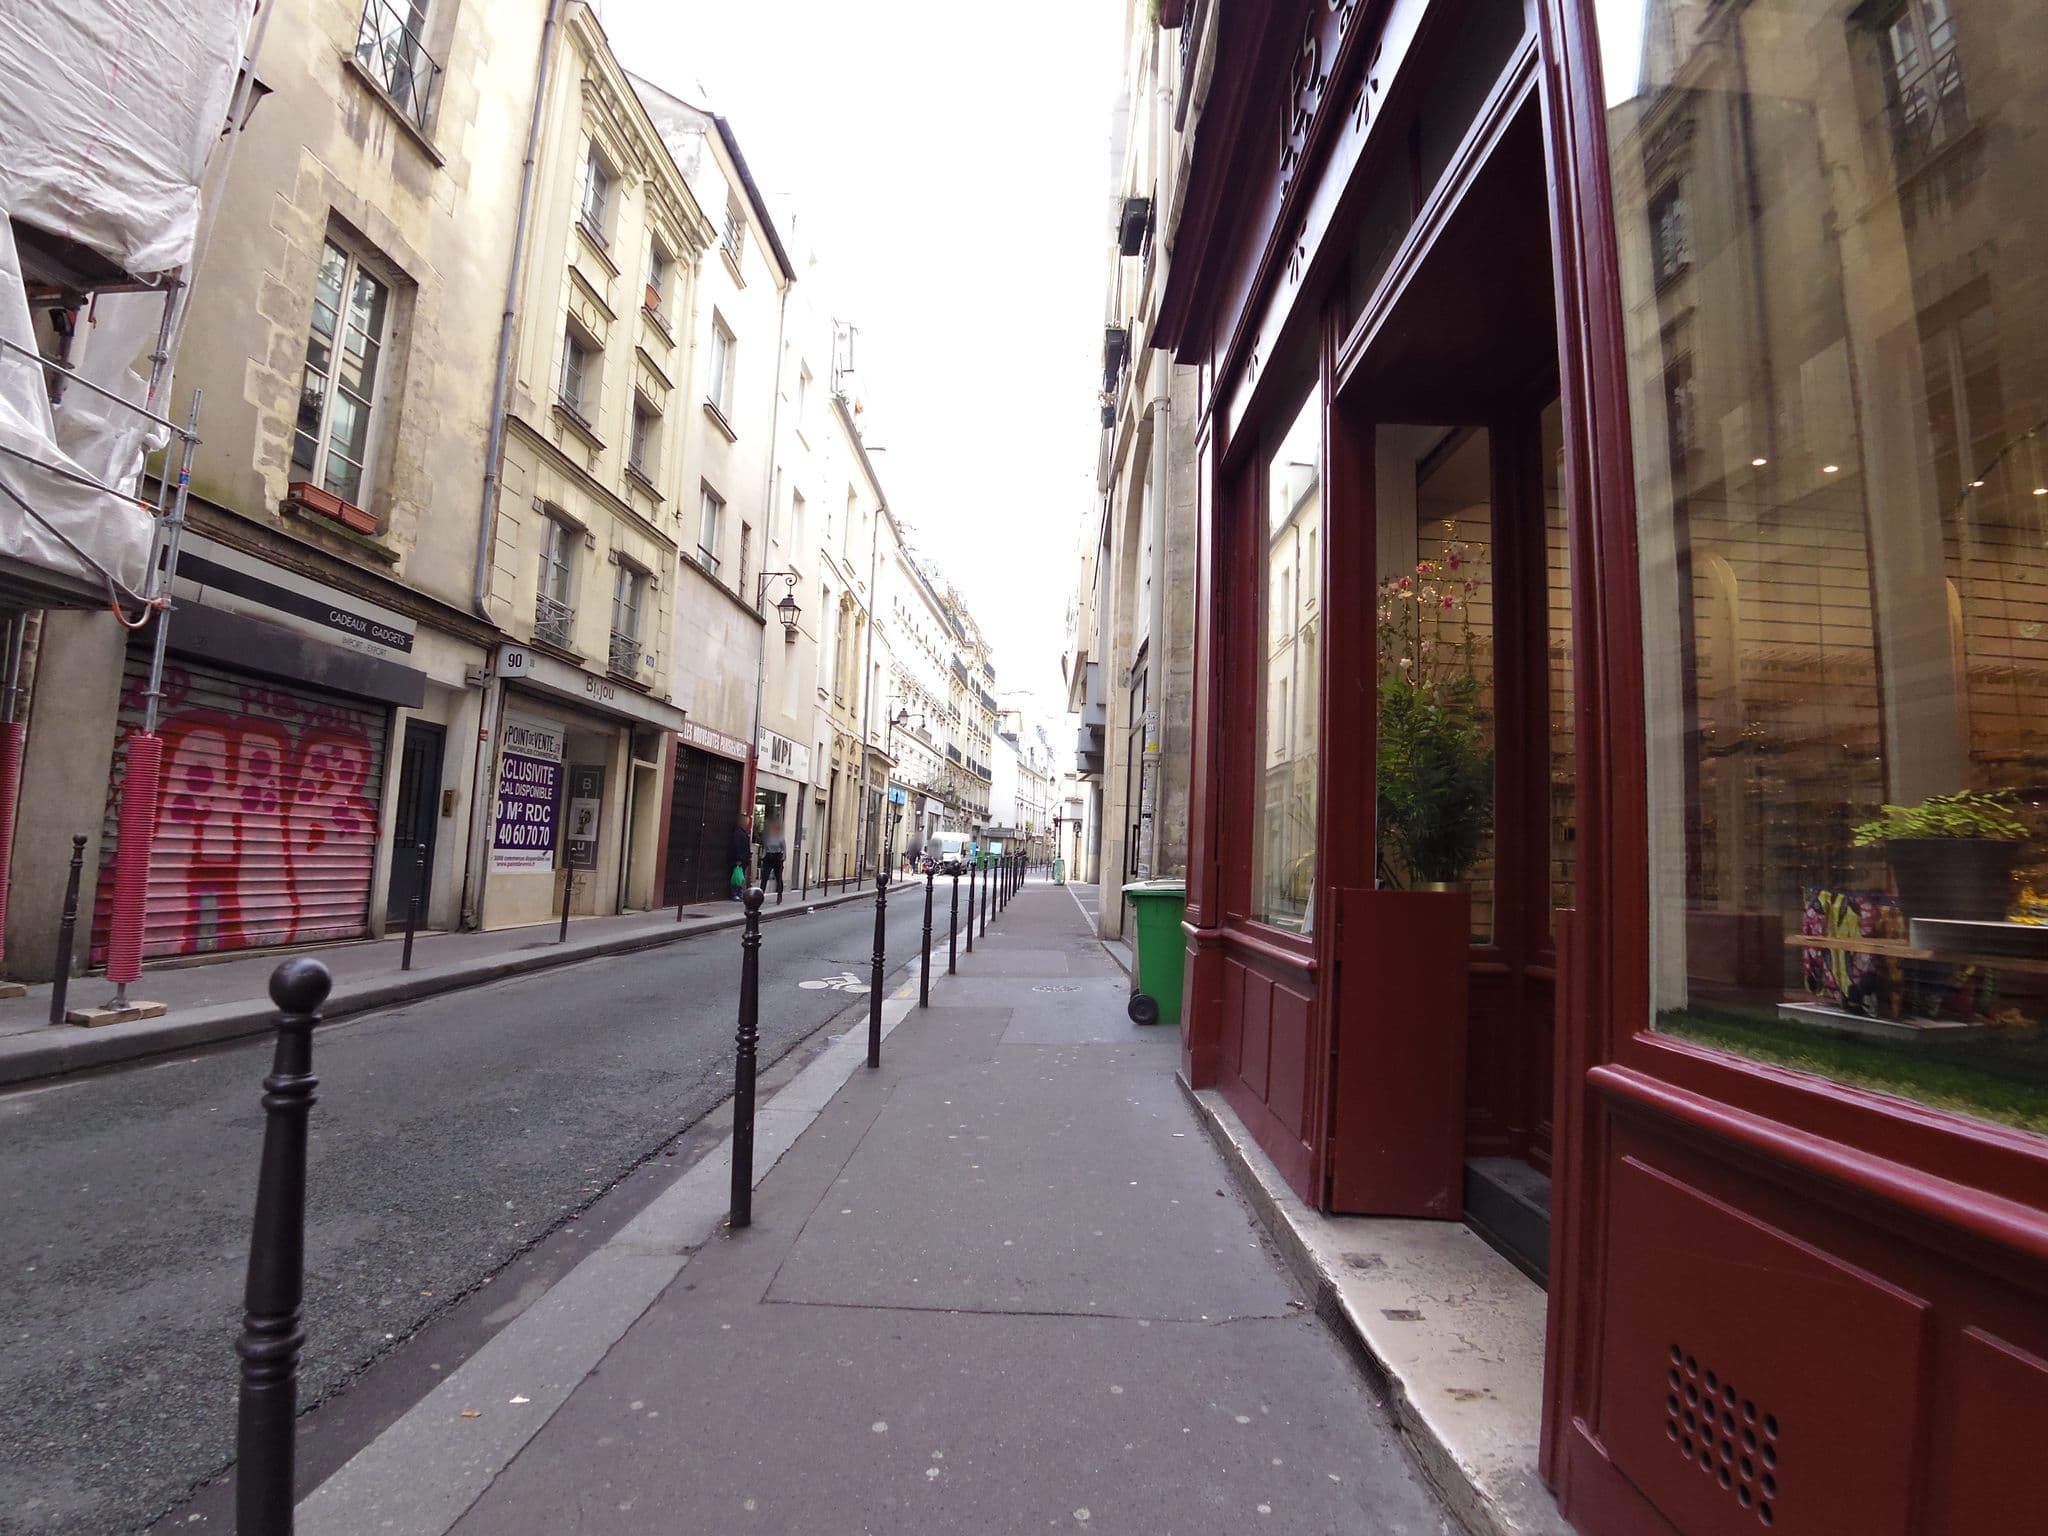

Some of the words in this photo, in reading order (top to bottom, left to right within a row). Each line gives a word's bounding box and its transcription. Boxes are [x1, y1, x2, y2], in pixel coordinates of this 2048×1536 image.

[329, 610, 367, 633] CADEAUX
[371, 625, 406, 646] GADGETS
[508, 653, 523, 669] 90
[772, 735, 792, 766] MPI
[515, 783, 552, 800] DISPONIBLE
[525, 803, 551, 823] RDC
[499, 823, 512, 845] 40
[513, 824, 525, 845] 60
[526, 825, 538, 846] 70
[538, 826, 550, 846] 70
